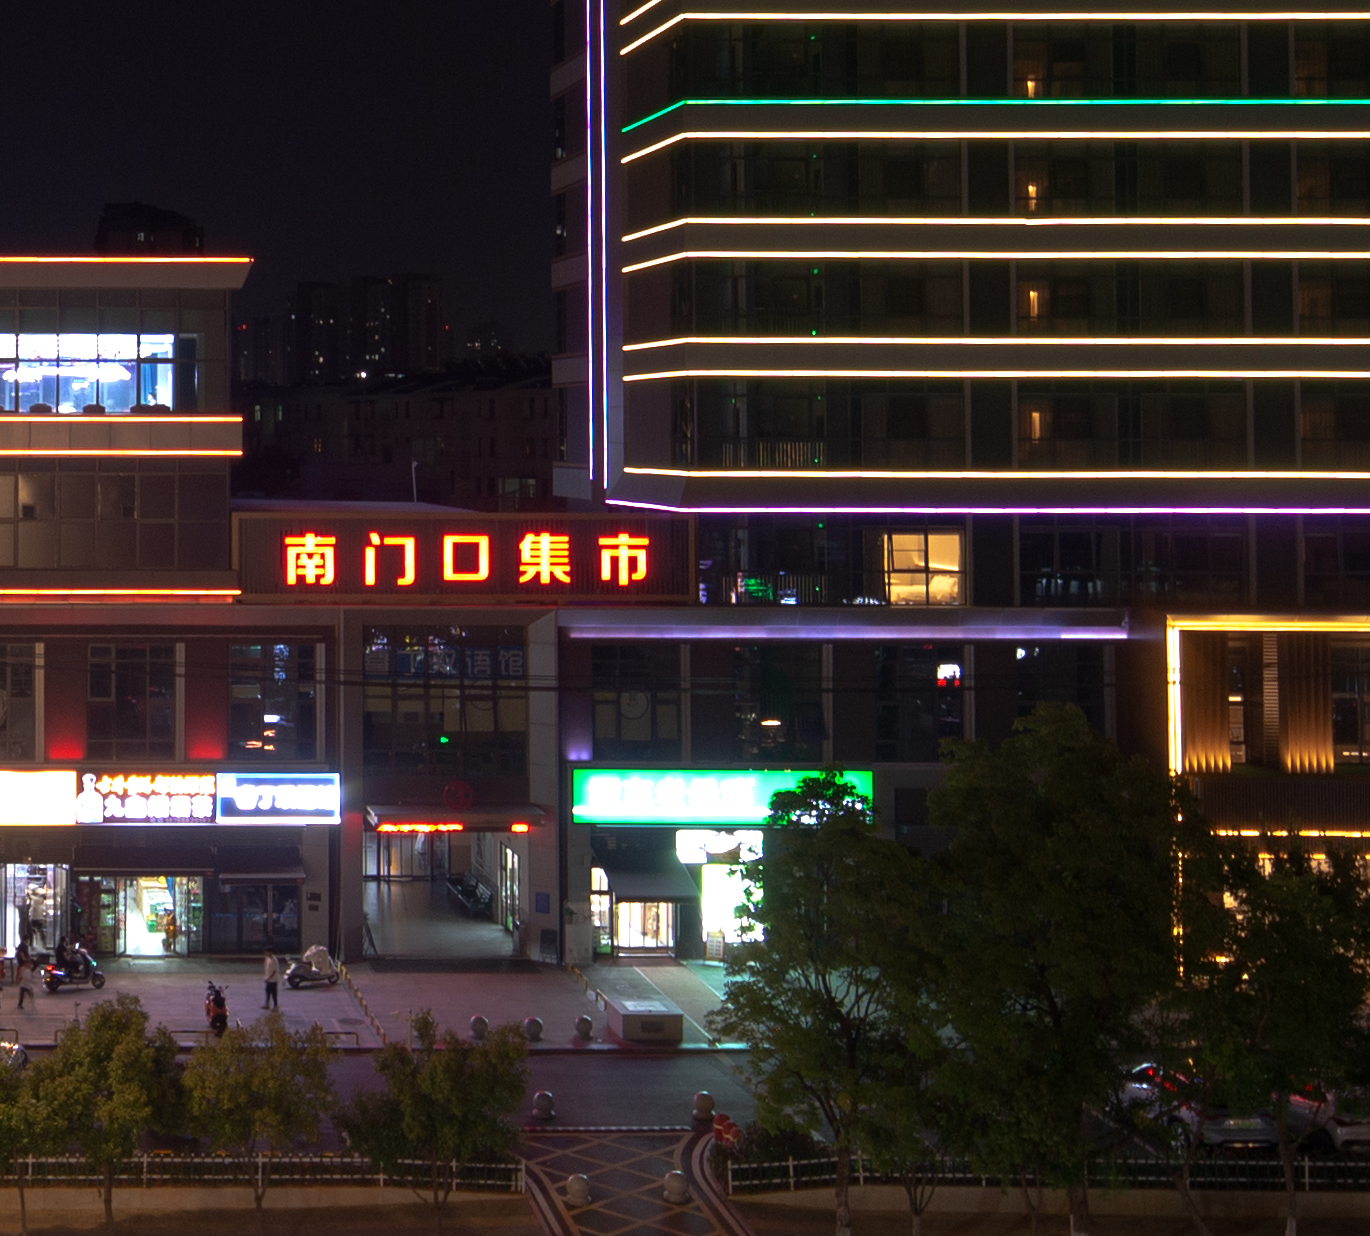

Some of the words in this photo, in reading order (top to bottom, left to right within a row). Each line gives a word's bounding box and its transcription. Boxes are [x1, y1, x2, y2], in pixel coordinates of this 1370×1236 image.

[284, 531, 651, 587] 南门口集市
